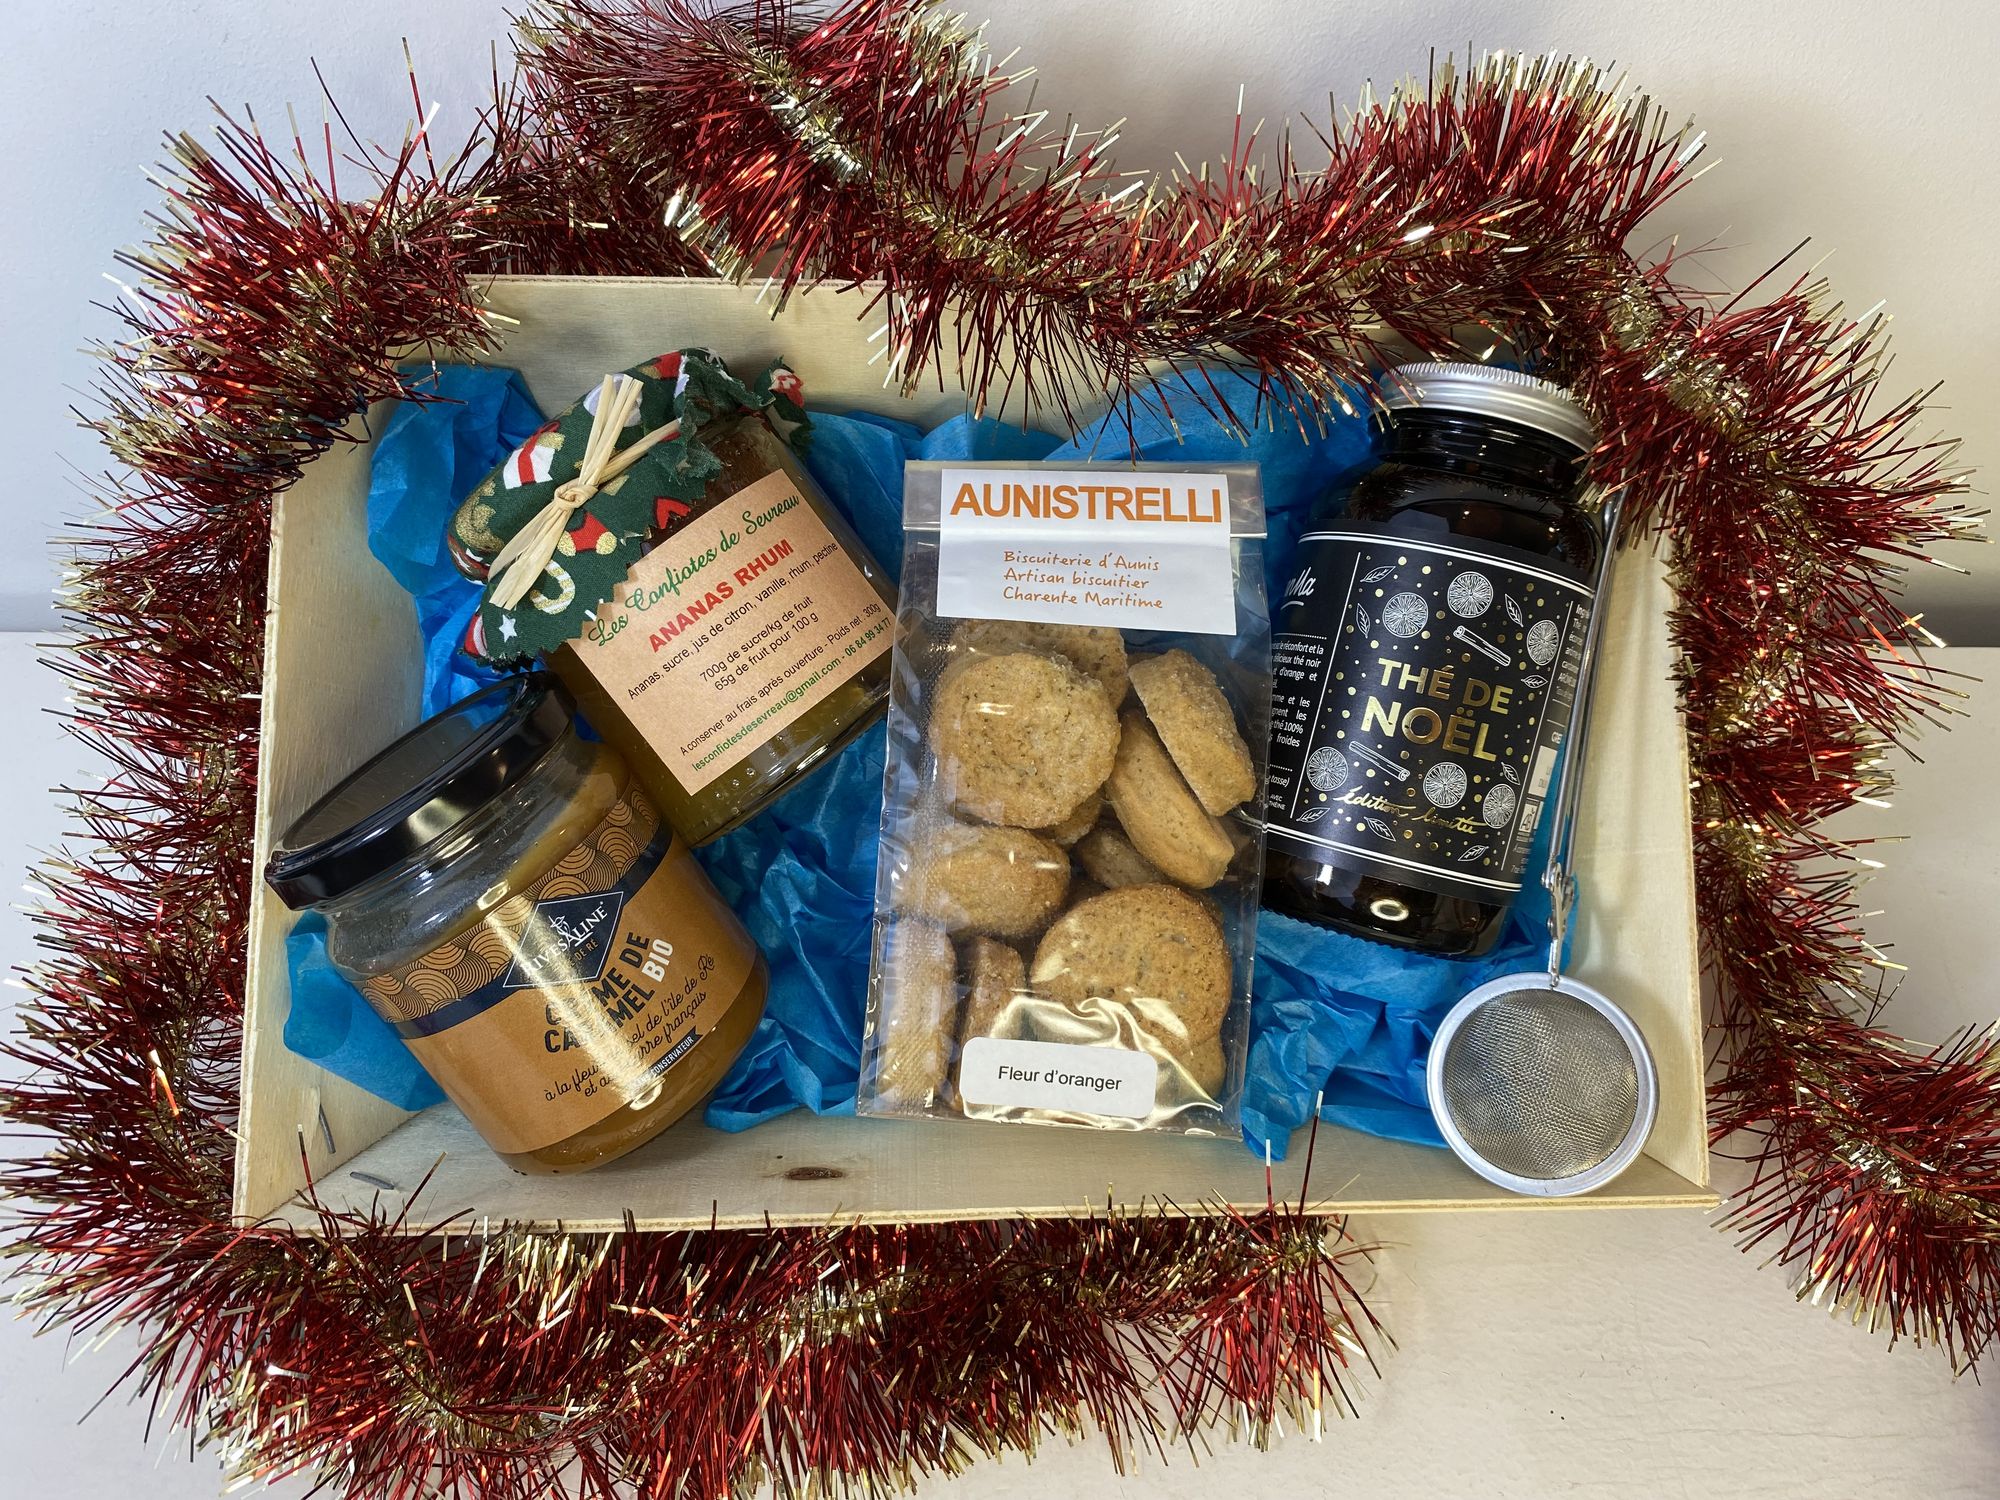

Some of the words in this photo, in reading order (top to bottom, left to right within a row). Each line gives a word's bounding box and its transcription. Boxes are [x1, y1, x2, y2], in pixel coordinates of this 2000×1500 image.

[949, 482, 1222, 523] AUNISTRELLI
[588, 613, 629, 647] Les
[625, 547, 717, 612] Confiotes
[720, 530, 740, 553] de
[742, 494, 800, 535] Sevreau
[1003, 550, 1092, 568] Biscuiterie
[1099, 552, 1160, 572] d'Aunis
[1003, 567, 1065, 584] Artisan
[1072, 570, 1150, 589] biscuitier
[648, 581, 734, 653] ANANAS
[733, 538, 795, 587] RHUM
[1003, 586, 1078, 605] Charente
[1085, 590, 1163, 609] Maritime
[627, 671, 665, 700] Ananas,
[662, 648, 695, 673] sucre,
[690, 633, 710, 653] jus
[709, 622, 724, 637] de
[724, 600, 758, 626] citron,
[754, 576, 791, 603] vanille,
[788, 559, 815, 580] rhum,
[812, 542, 838, 565] pectine
[700, 660, 728, 682] 700g
[727, 650, 741, 664] de
[740, 619, 783, 653] sucre/kg
[781, 610, 795, 623] de
[793, 596, 814, 613] fruit
[714, 673, 737, 691] 65g
[735, 663, 750, 677] de
[748, 647, 771, 666] fruit
[769, 630, 792, 653] pour
[791, 616, 811, 633] 100
[810, 611, 819, 623] g
[1293, 653, 1304, 666] thé
[1305, 657, 1322, 668] noir
[1308, 644, 1317, 654] et
[1316, 643, 1324, 655] la
[679, 746, 689, 757] A
[686, 718, 725, 753] conserver
[724, 709, 738, 723] au
[736, 695, 758, 713] frais
[757, 675, 784, 699] après
[783, 645, 824, 679] ouverture
[826, 624, 851, 645] Poids
[849, 615, 863, 627] net
[862, 602, 882, 618] 300g
[692, 657, 842, 772] lesconfiotesdesevreau@gmail.com
[844, 644, 857, 657] 06
[854, 636, 867, 649] 84
[864, 629, 876, 641] 99
[873, 623, 885, 635] 34
[881, 617, 892, 629] 77
[1308, 671, 1318, 682] et
[1378, 657, 1455, 701] THÉ
[1462, 677, 1514, 715] DE
[1287, 695, 1296, 705] et
[1299, 696, 1311, 708] les
[1295, 709, 1308, 721] les
[1276, 732, 1301, 748] froides
[1284, 721, 1304, 735] 100%
[1360, 695, 1497, 762] NOËL
[618, 931, 650, 969] DE
[641, 938, 674, 983] BIO
[543, 1088, 556, 1102] à
[554, 1080, 572, 1097] la
[645, 1013, 663, 1034] de
[684, 976, 698, 998] de
[697, 954, 715, 980] Ré
[584, 1081, 598, 1098] et
[662, 990, 707, 1043] français
[650, 1035, 695, 1077] CONSERVATEUR
[998, 1065, 1041, 1083] Fleur
[1043, 1069, 1123, 1092] d'oranger
